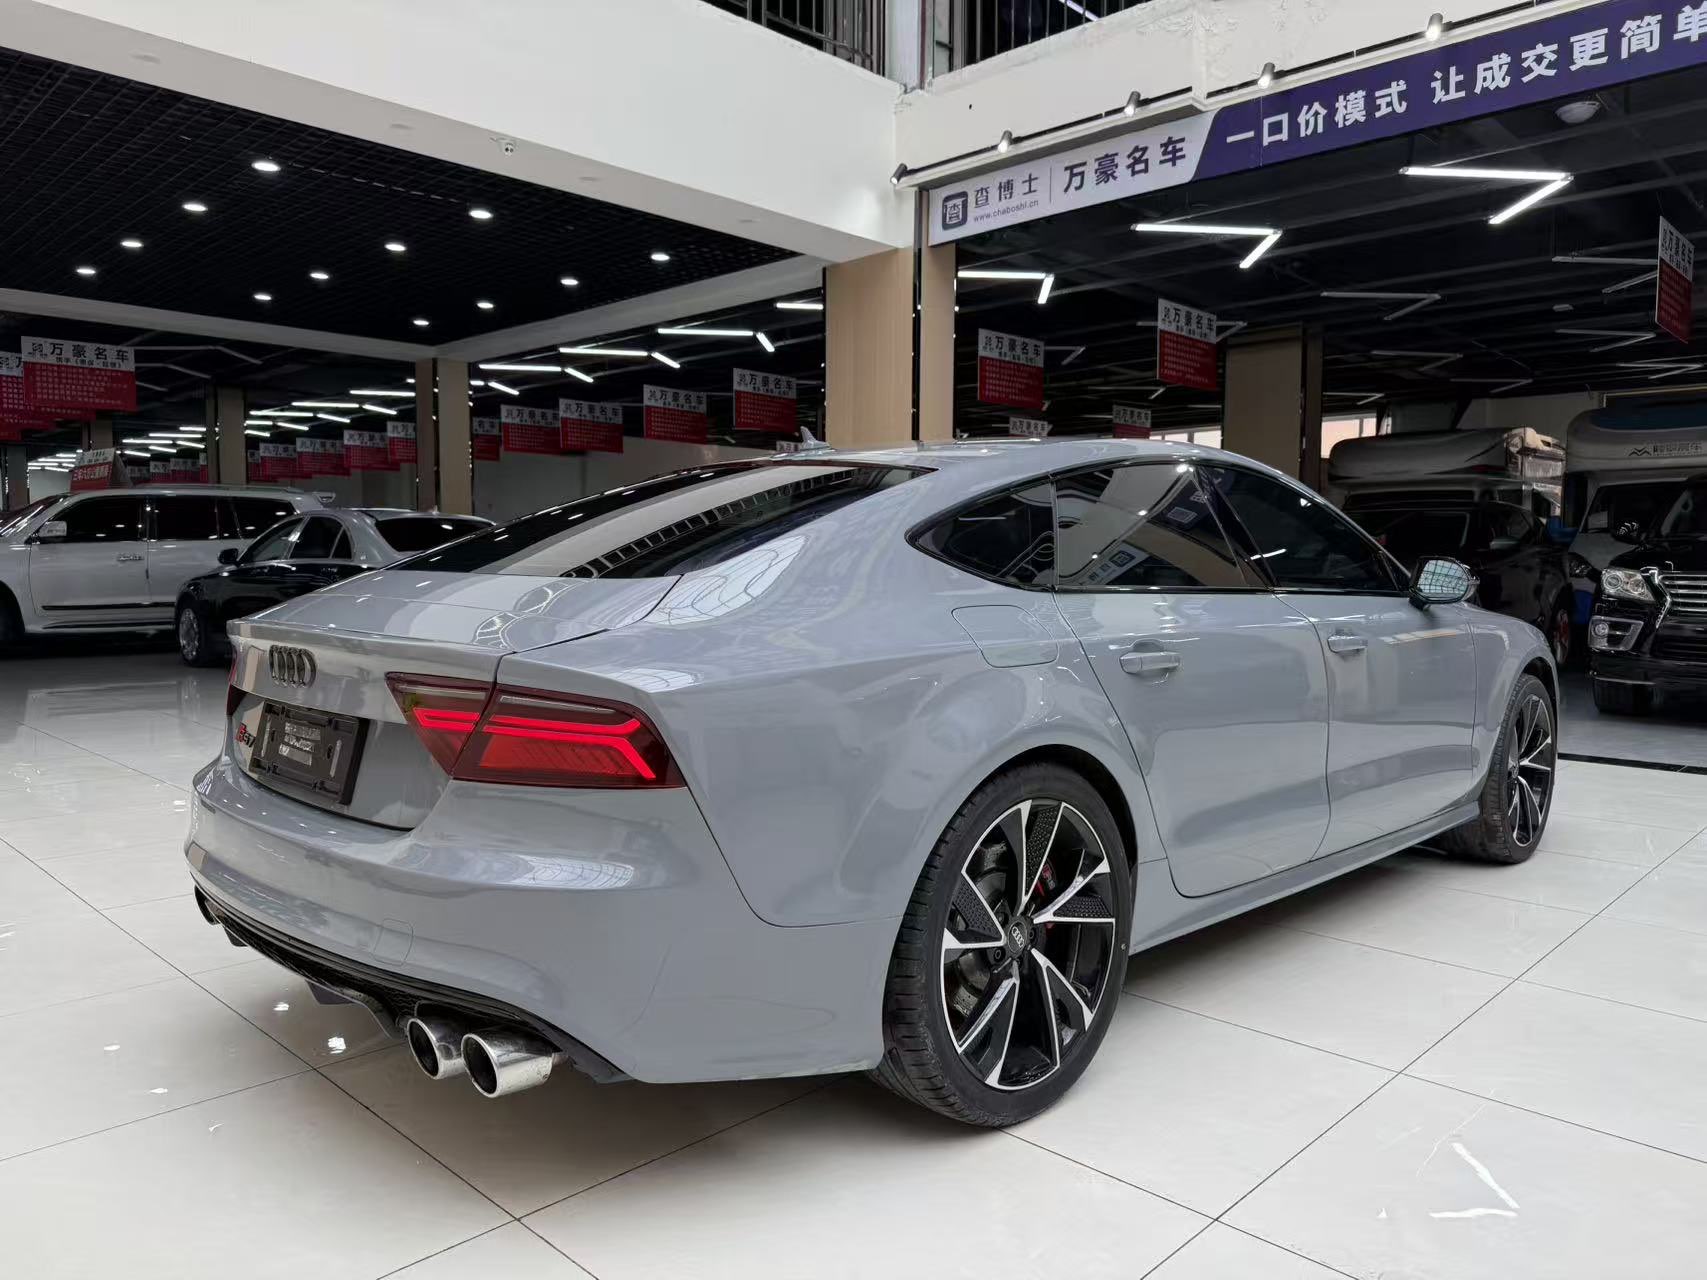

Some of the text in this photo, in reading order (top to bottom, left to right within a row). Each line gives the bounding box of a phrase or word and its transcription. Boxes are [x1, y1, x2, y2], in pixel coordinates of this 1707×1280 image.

[1226, 2, 1707, 147] 一口价模式 让成交更简单
[1063, 136, 1186, 194] 万豪名车
[974, 172, 1038, 209] 查博士
[974, 200, 1039, 223] www.chaboshi.cn
[1173, 307, 1214, 331] 万豪名车
[50, 343, 128, 362] 万豪名车
[995, 336, 1040, 357] 万豪名车
[749, 373, 793, 390] 万豪名车
[659, 388, 704, 405] 万豪名车
